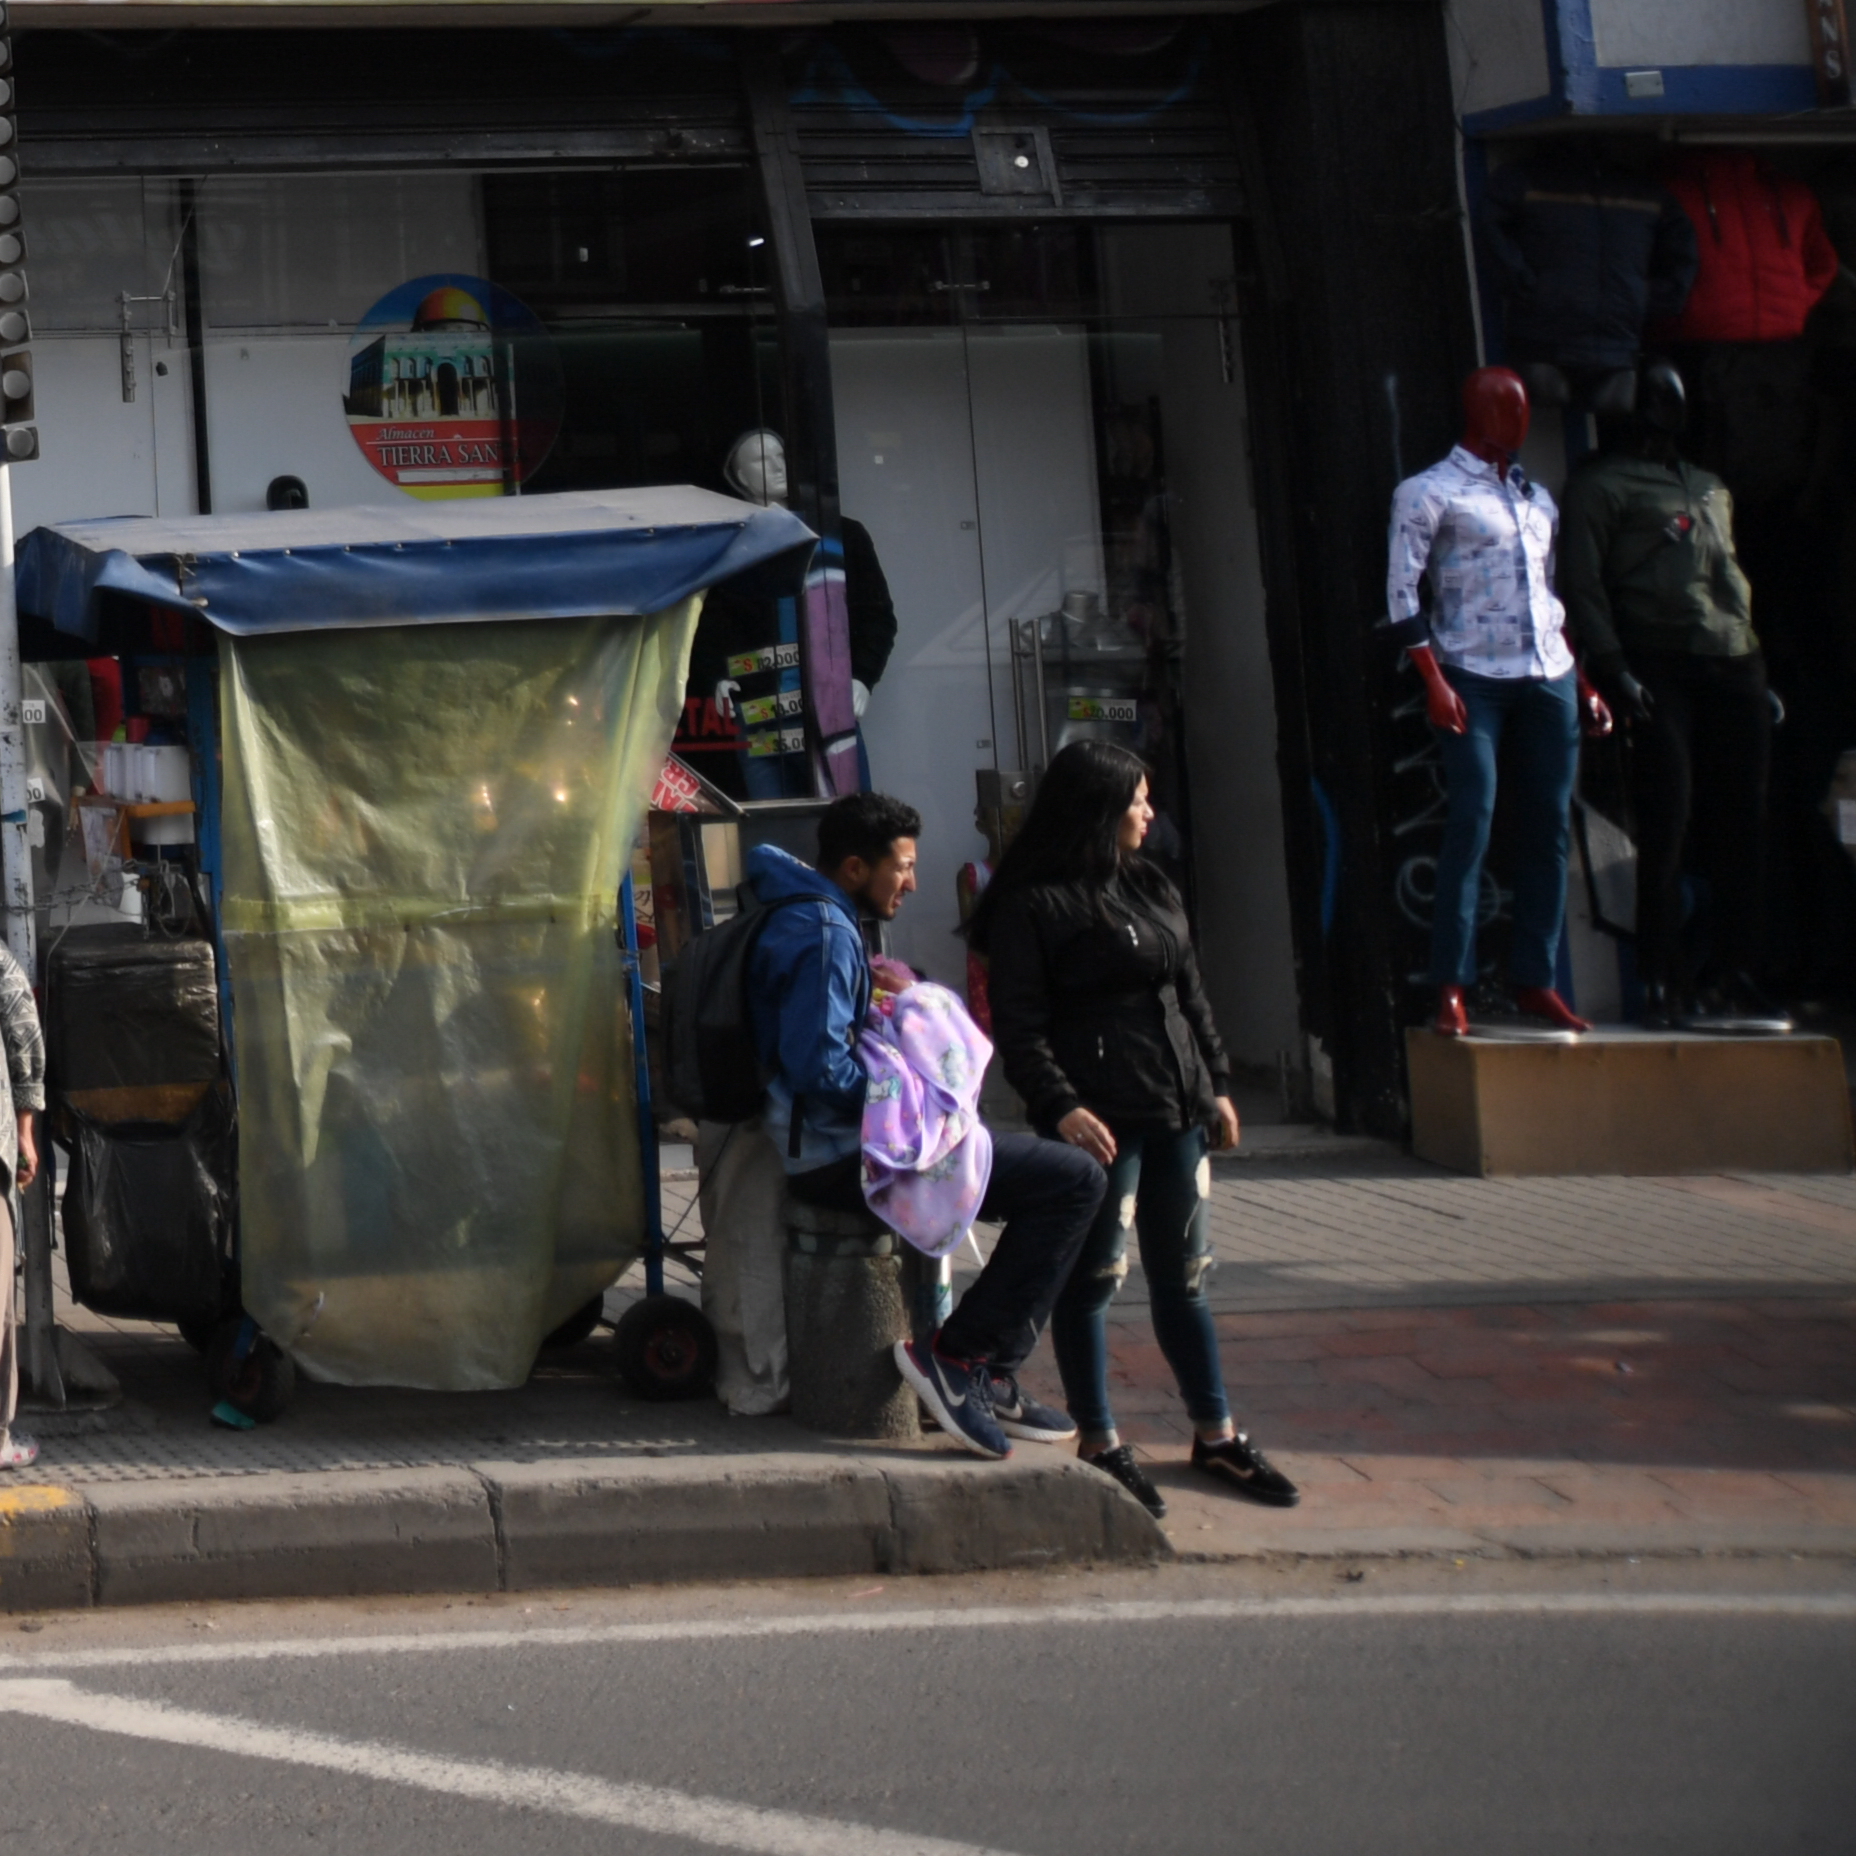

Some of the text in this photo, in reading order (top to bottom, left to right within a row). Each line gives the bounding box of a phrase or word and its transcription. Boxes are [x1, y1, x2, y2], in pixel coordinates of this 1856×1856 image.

[377, 427, 435, 441] Almacen
[377, 443, 500, 467] TIERRA SAN
